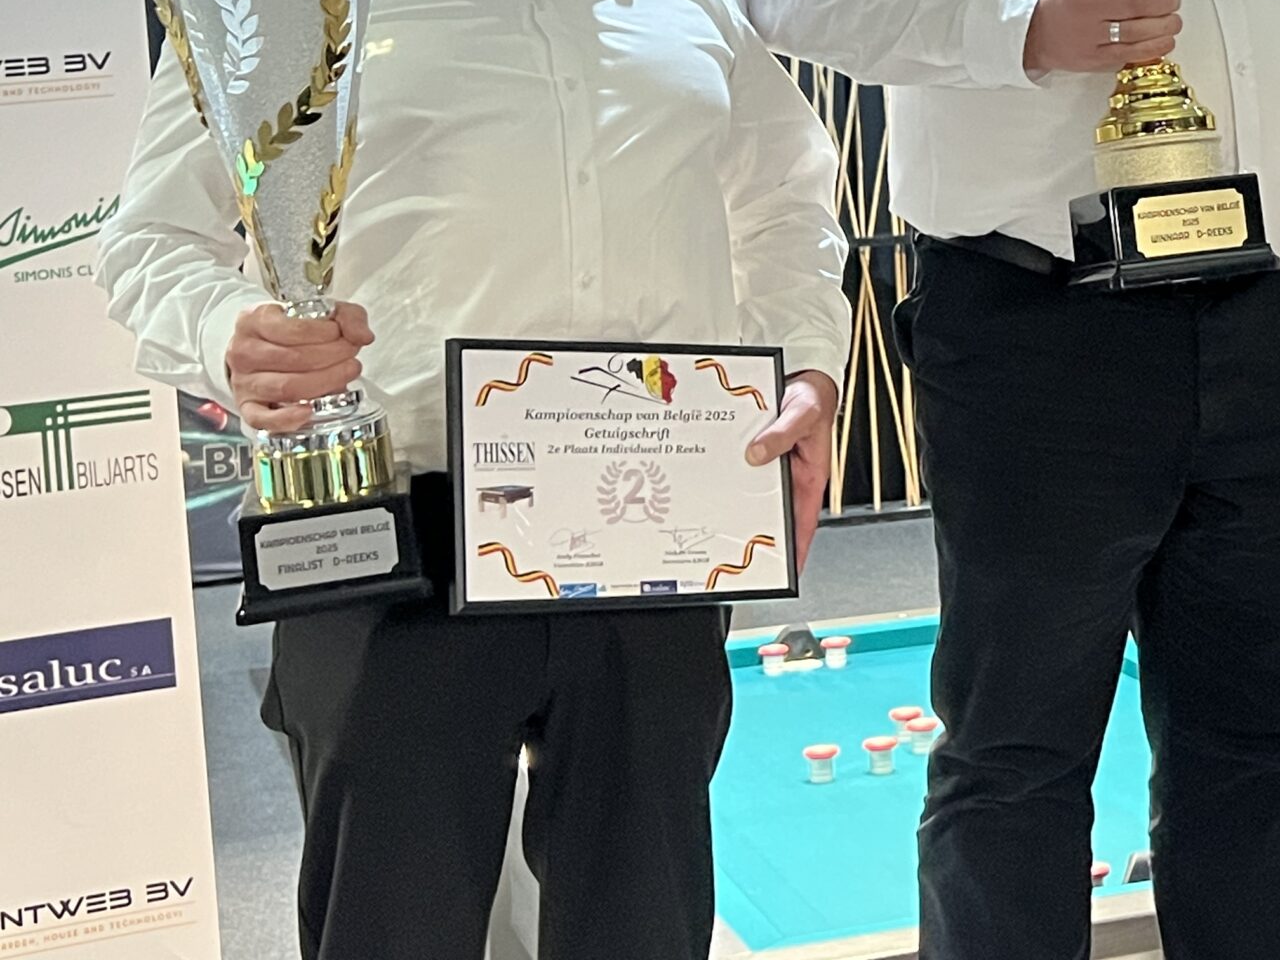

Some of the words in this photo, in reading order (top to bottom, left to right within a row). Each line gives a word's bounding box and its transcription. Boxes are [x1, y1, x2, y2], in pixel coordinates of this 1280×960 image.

[63, 51, 112, 74] BV
[1196, 226, 1233, 239] D-REEKS
[14, 266, 73, 283] SIMONIS
[524, 409, 633, 424] Kampioenschap
[635, 411, 660, 422] van
[663, 409, 702, 424] België
[704, 410, 735, 421] 2025
[584, 427, 670, 442] Getuigschrift
[472, 440, 536, 464] THISSEN
[547, 444, 561, 454] 2e
[563, 444, 599, 454] Plaats
[600, 444, 662, 454] Individueel
[664, 444, 673, 454] D
[676, 444, 706, 454] Reeks
[76, 453, 159, 489] BILJARTS
[622, 467, 646, 504] 2
[278, 559, 325, 575] FINALIST
[333, 551, 380, 567] D-REEKS
[0, 658, 122, 698] saluc
[146, 877, 194, 903] BV
